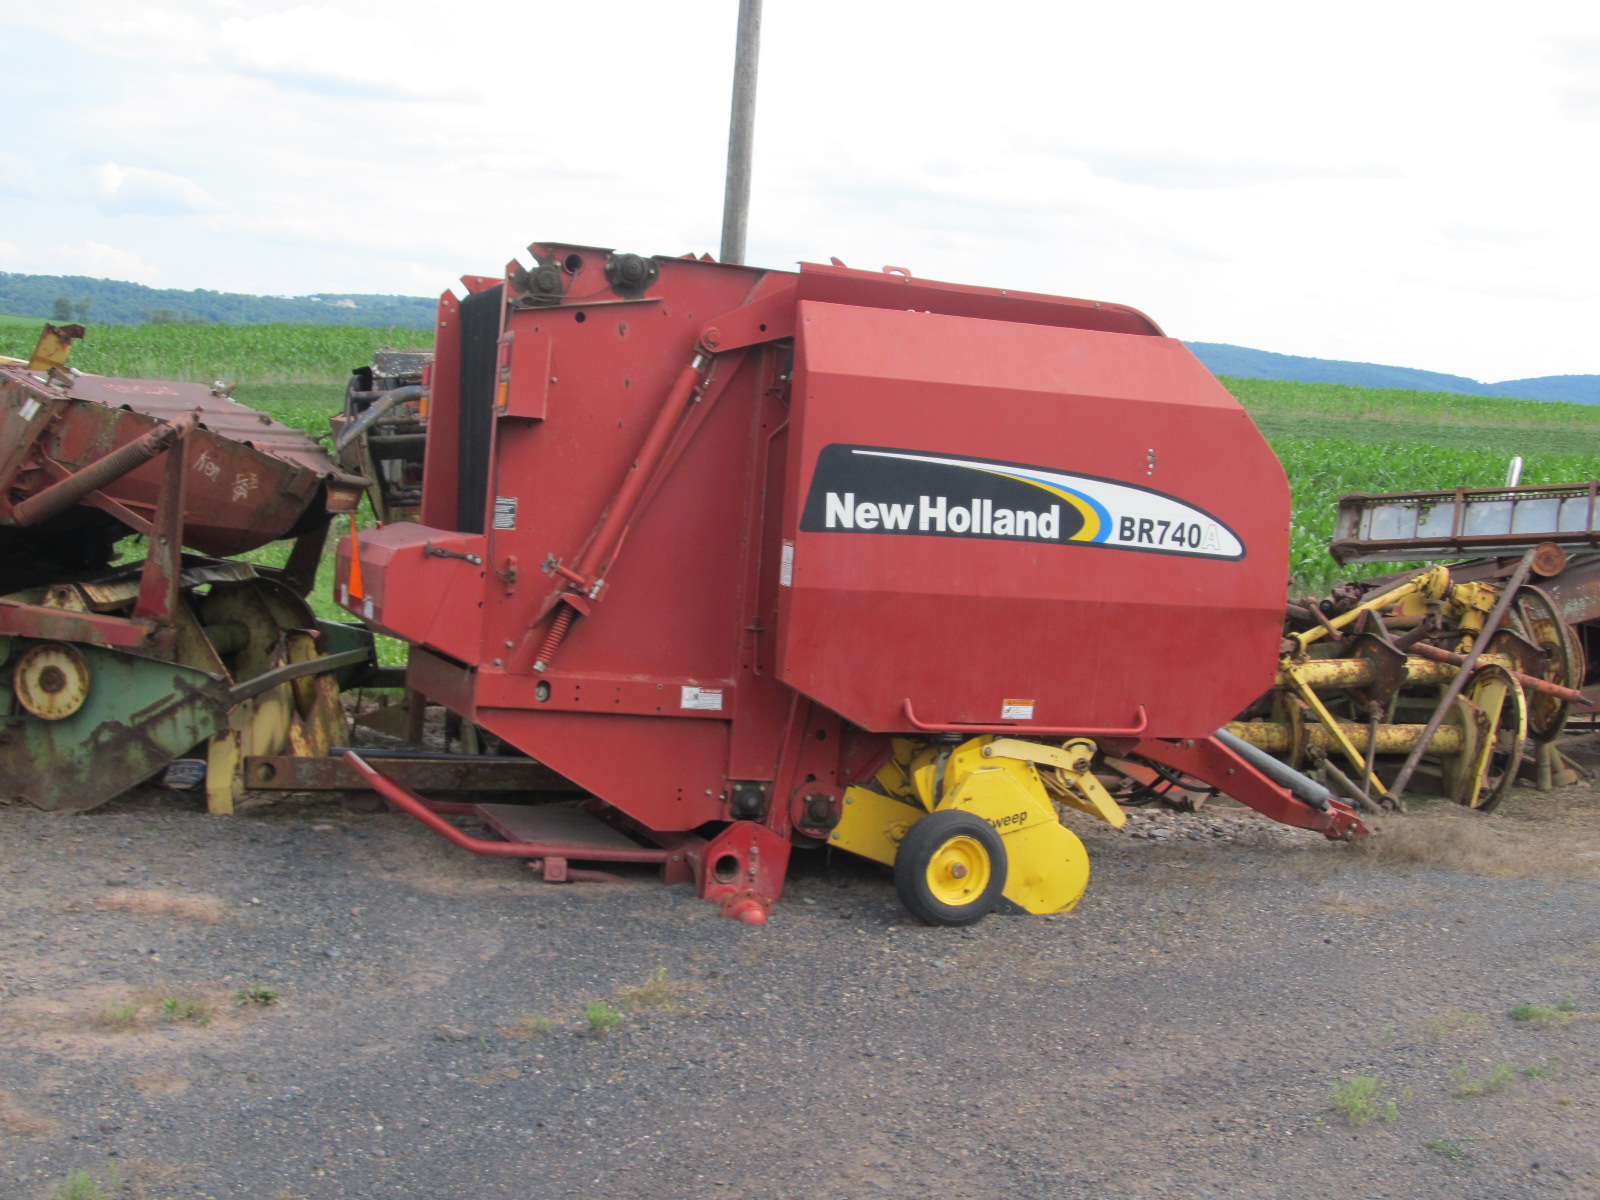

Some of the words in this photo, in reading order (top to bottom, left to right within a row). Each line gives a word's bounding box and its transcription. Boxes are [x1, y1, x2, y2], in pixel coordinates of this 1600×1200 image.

[825, 492, 915, 530] New
[919, 495, 1060, 539] Holland
[1119, 515, 1221, 551] BR740A
